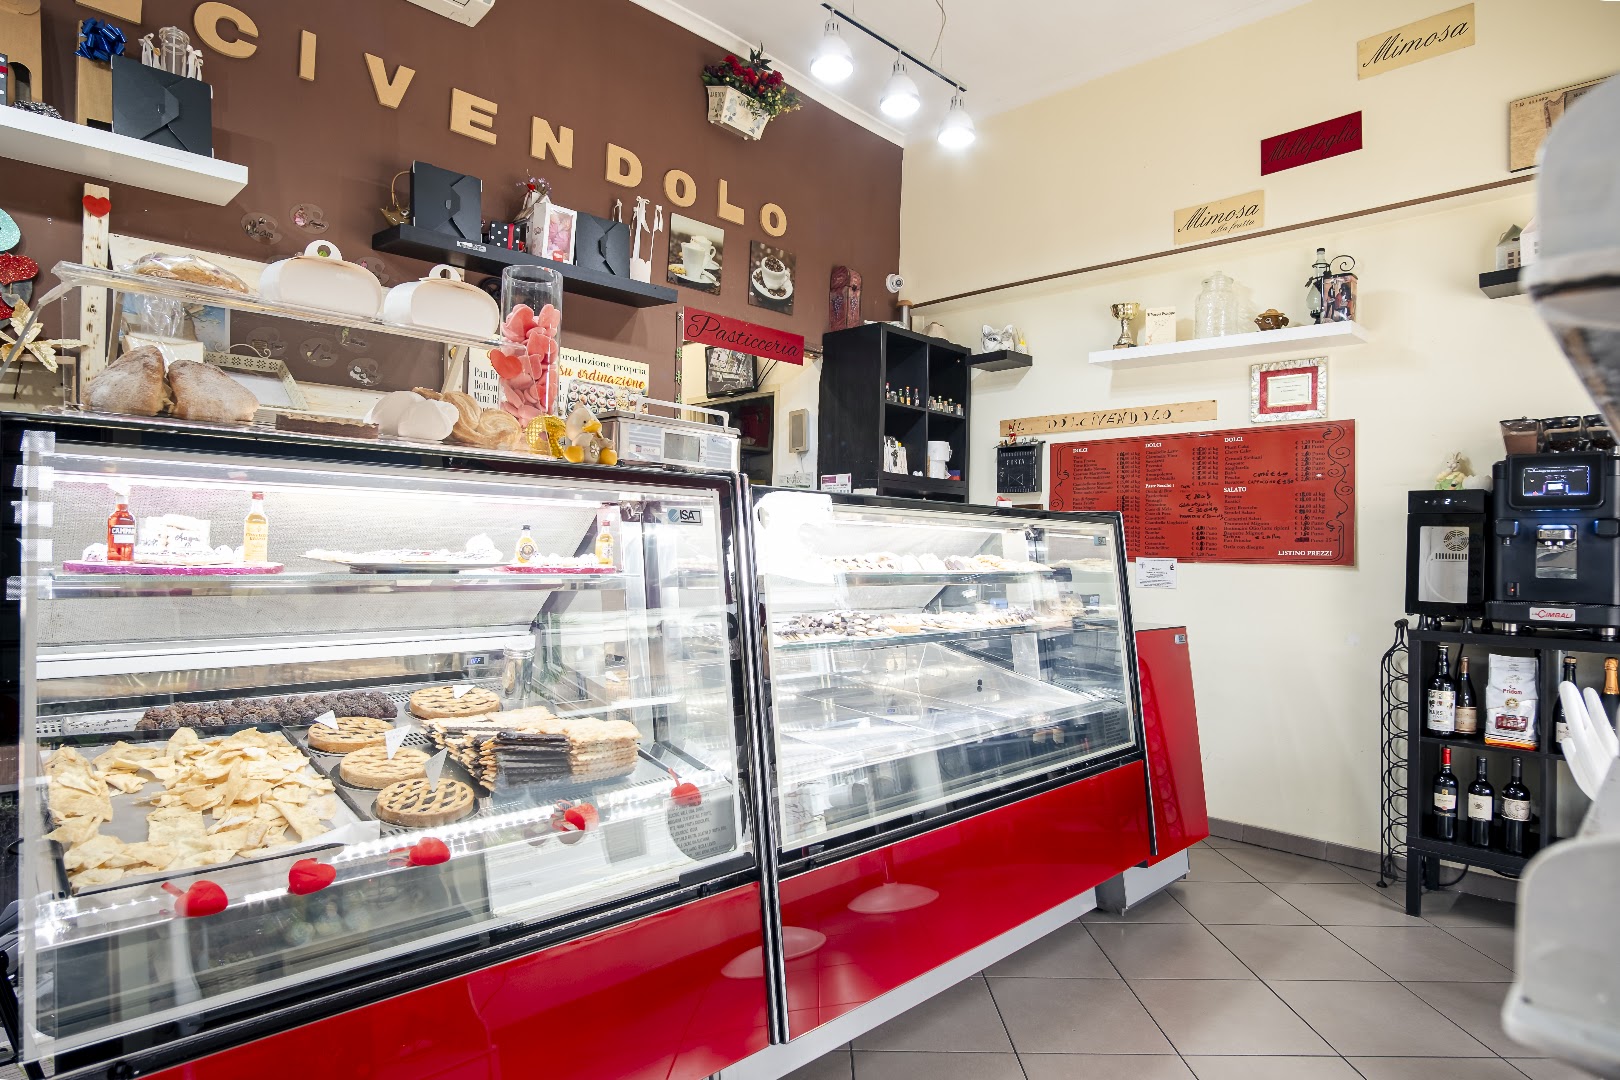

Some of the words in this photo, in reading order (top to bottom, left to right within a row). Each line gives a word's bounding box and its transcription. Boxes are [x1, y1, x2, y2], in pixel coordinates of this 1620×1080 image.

[1362, 21, 1469, 67] Mimosa
[1263, 118, 1359, 164] Millefoglie
[1177, 204, 1259, 232] Mimosa
[1210, 222, 1228, 234] alla
[1228, 219, 1255, 234] frutta
[686, 312, 800, 357] Pasticceria
[577, 369, 646, 390] ordinazione
[613, 364, 647, 375] propria
[680, 510, 695, 520] ISA
[1537, 610, 1573, 619] CIMBALI
